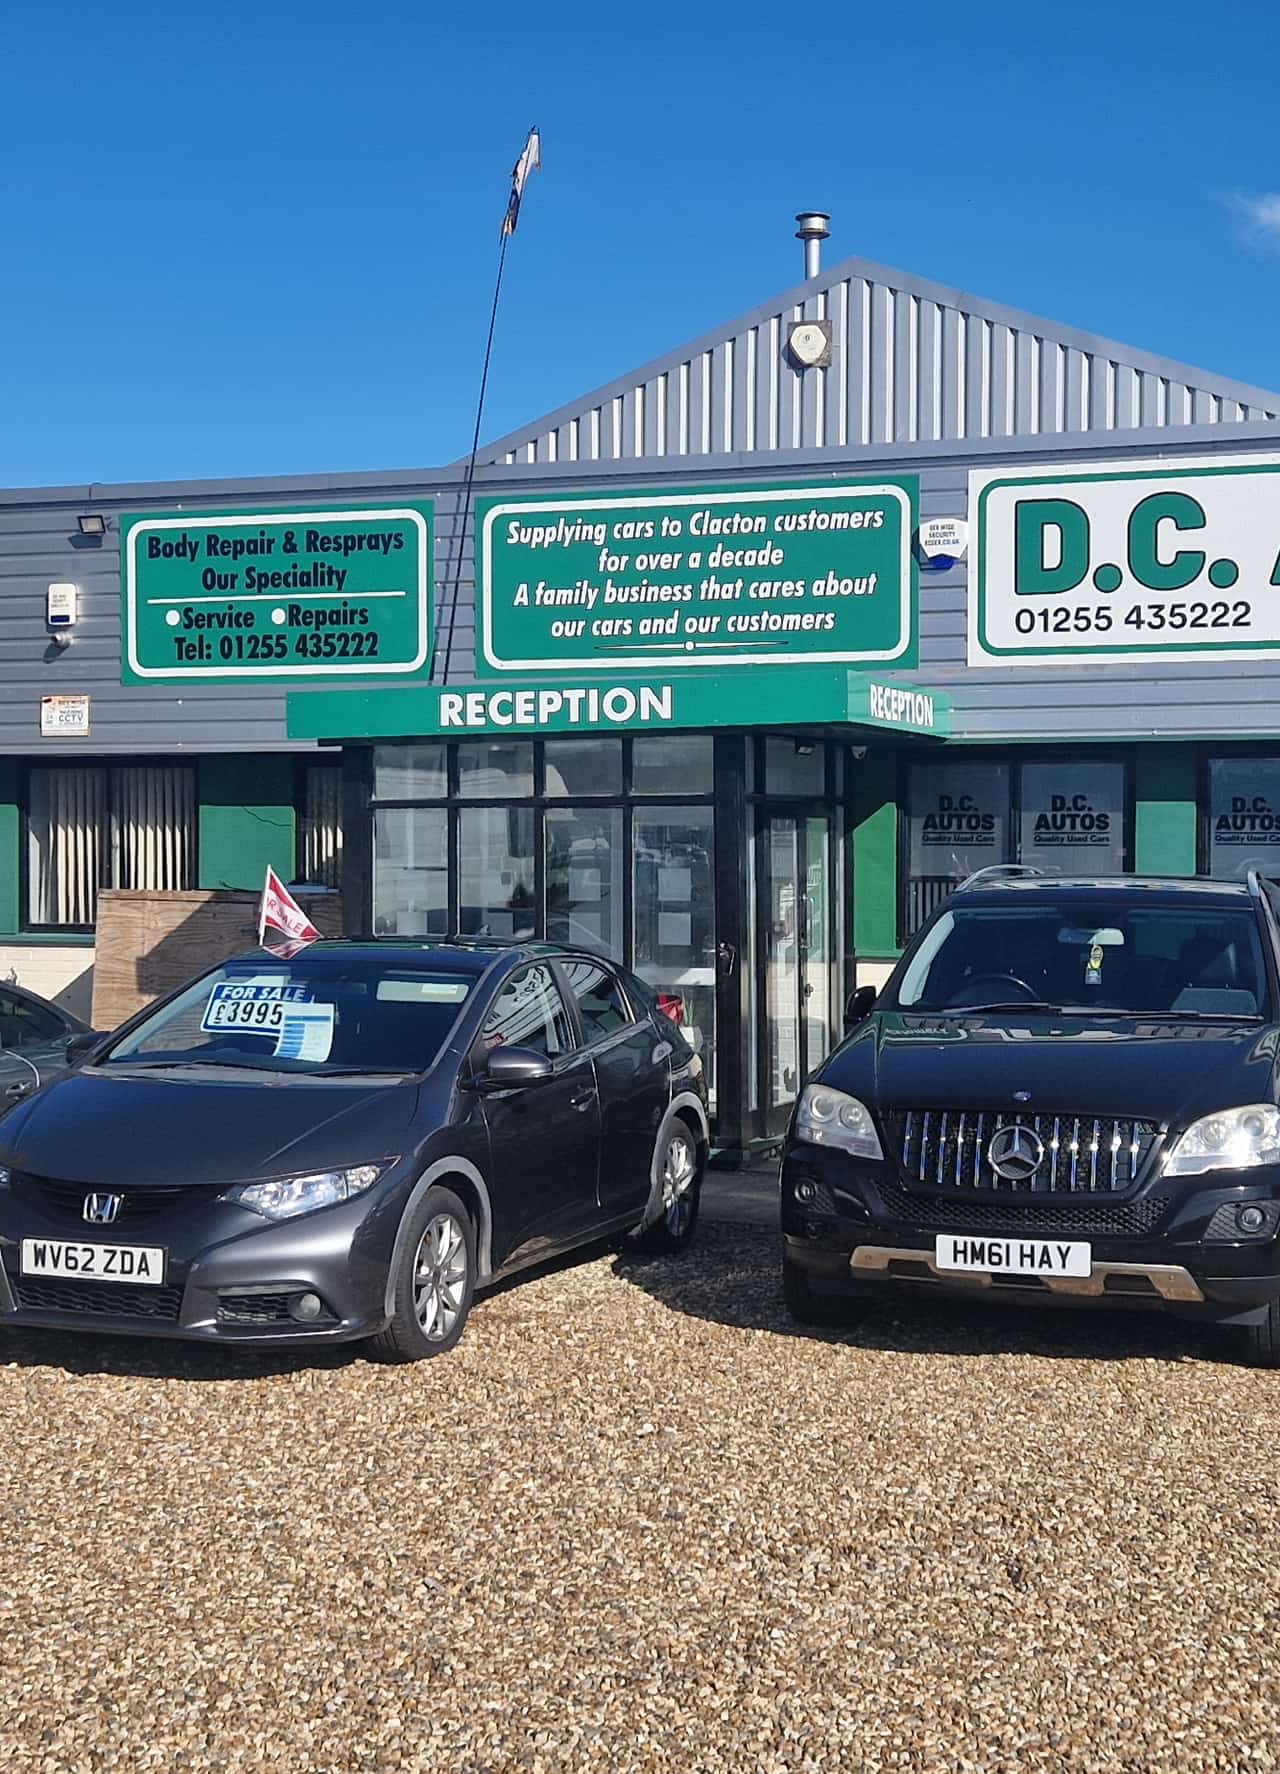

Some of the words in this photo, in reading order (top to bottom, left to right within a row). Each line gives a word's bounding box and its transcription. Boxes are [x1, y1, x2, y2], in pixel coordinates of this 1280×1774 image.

[507, 517, 607, 549] Supplying
[613, 520, 654, 539] cars
[661, 516, 682, 537] to
[689, 510, 767, 536] Clacton
[774, 509, 884, 532] customers
[1014, 490, 1239, 595] D.C.
[148, 533, 199, 562] Body
[207, 531, 276, 560] Repair
[282, 531, 298, 552] &
[306, 530, 404, 557] Resprays
[598, 548, 629, 572] for
[635, 552, 682, 571] over
[688, 551, 702, 569] a
[708, 540, 784, 568] decade
[202, 567, 238, 591] Our
[245, 563, 347, 593] Speciality
[513, 583, 529, 606] A
[535, 581, 599, 610] family
[603, 579, 692, 604] business
[700, 575, 743, 600] that
[748, 580, 805, 599] cares
[812, 570, 877, 597] about
[182, 604, 255, 630] Service
[288, 601, 369, 630] Repairs
[551, 620, 586, 637] our
[591, 618, 633, 636] cars
[639, 609, 680, 635] and
[685, 616, 721, 633] our
[726, 610, 836, 633] customers
[1015, 605, 1113, 634] 01255
[1123, 600, 1252, 631] 435222
[174, 635, 212, 661] Tel:
[220, 634, 287, 659] 01255
[295, 632, 378, 657] 435222
[58, 714, 84, 722] CCTV
[439, 685, 672, 727] RECEPTION
[869, 684, 934, 727] RECEPTION
[939, 795, 978, 812] D.C.
[1051, 794, 1093, 812] D.C.
[1232, 796, 1272, 813] D.C.
[922, 813, 995, 831] AUTOS
[1034, 813, 1110, 831] AUTOS
[921, 834, 952, 844] Quality
[953, 833, 973, 842] Used
[975, 833, 995, 842] Cars
[1033, 834, 1065, 844] Quality
[1066, 833, 1088, 842] Used
[1090, 833, 1110, 842] Cars
[1215, 834, 1245, 844] Quality
[1246, 833, 1268, 842] Used
[221, 986, 254, 1000] FOR
[259, 987, 306, 1002] SALE
[33, 1243, 95, 1272] WV62
[103, 1249, 150, 1276] ZDA
[953, 1240, 1010, 1267] HM61
[1020, 1244, 1071, 1269] HAY
